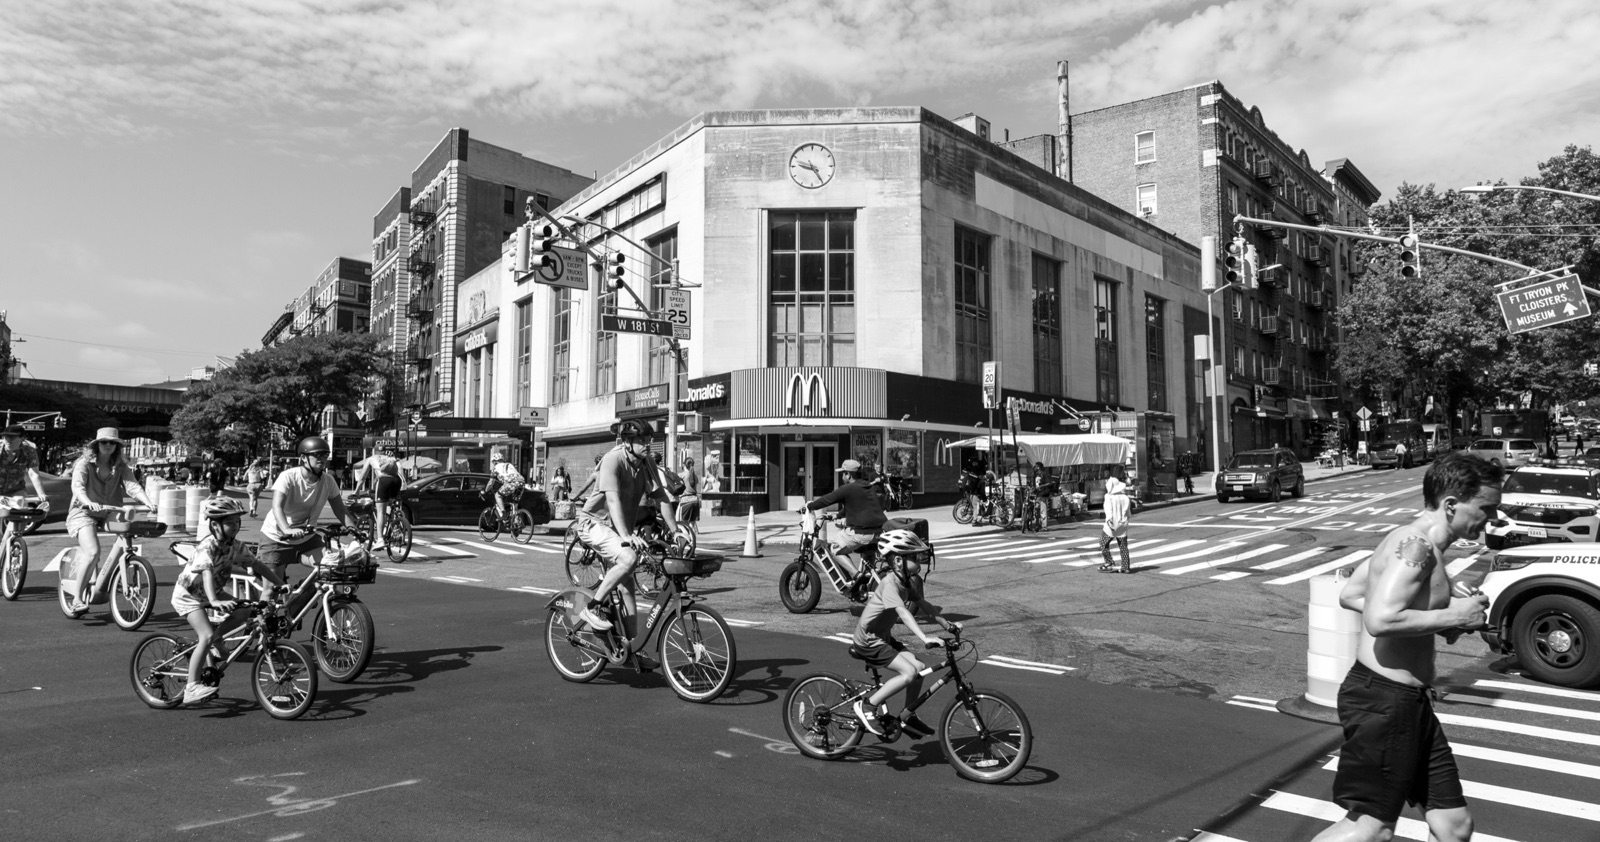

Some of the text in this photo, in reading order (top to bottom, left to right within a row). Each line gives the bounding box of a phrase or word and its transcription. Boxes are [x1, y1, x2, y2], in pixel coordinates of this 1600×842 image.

[566, 268, 583, 276] TRUCKS
[1509, 281, 1569, 304] FT TRYON PK
[1519, 293, 1567, 313] CLOISTERS
[668, 309, 688, 324] 25
[1516, 309, 1556, 326] MUSEUM
[617, 319, 660, 333] W 181 St
[985, 373, 994, 383] 20
[634, 387, 660, 401] HouseCalls
[678, 382, 724, 402] Donald's
[855, 439, 878, 447] DRINKS
[1553, 555, 1597, 564] POLICE
